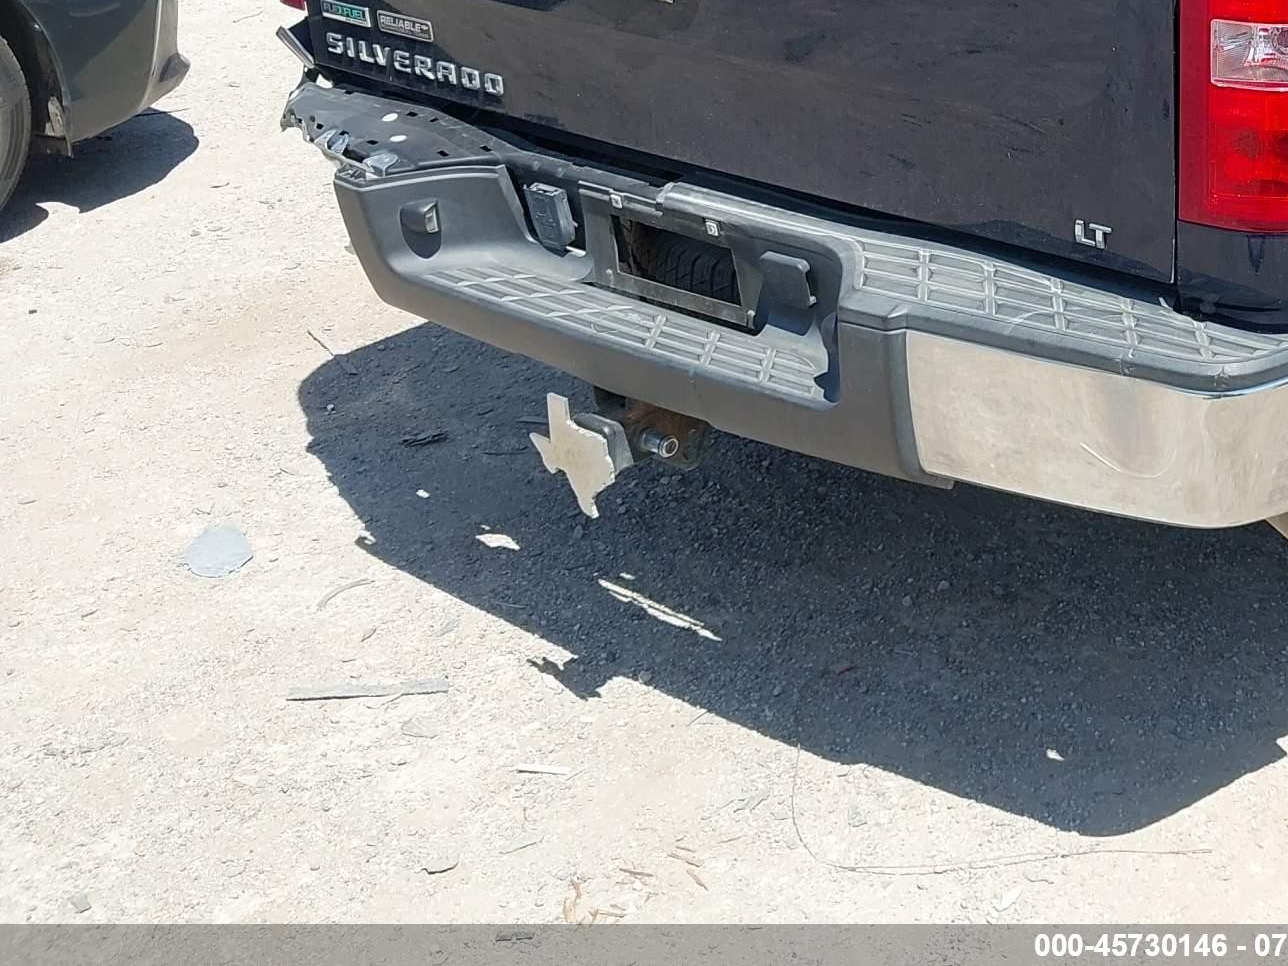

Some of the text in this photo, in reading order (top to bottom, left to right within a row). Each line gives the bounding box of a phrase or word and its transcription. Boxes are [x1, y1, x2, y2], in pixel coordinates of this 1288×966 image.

[380, 15, 422, 33] RELIABLE
[326, 32, 504, 97] SILVERADO
[1074, 219, 1113, 249] LT
